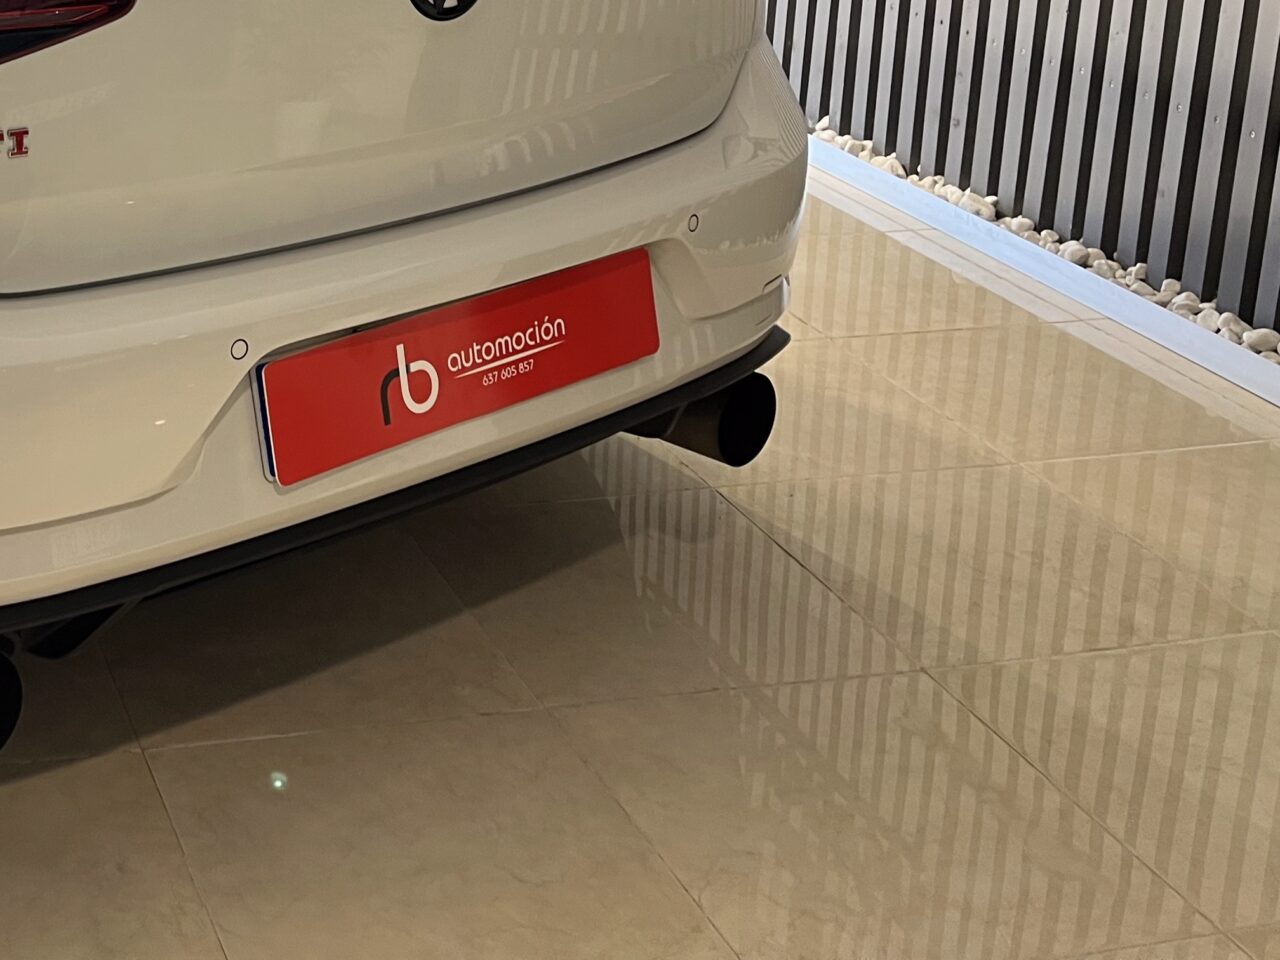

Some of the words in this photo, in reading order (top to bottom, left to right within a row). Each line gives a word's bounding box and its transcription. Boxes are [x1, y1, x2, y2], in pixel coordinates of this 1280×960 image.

[447, 315, 566, 372] automoción
[380, 343, 440, 427] rb
[482, 370, 499, 387] 637
[500, 365, 518, 380] 605
[518, 359, 535, 374] 857
